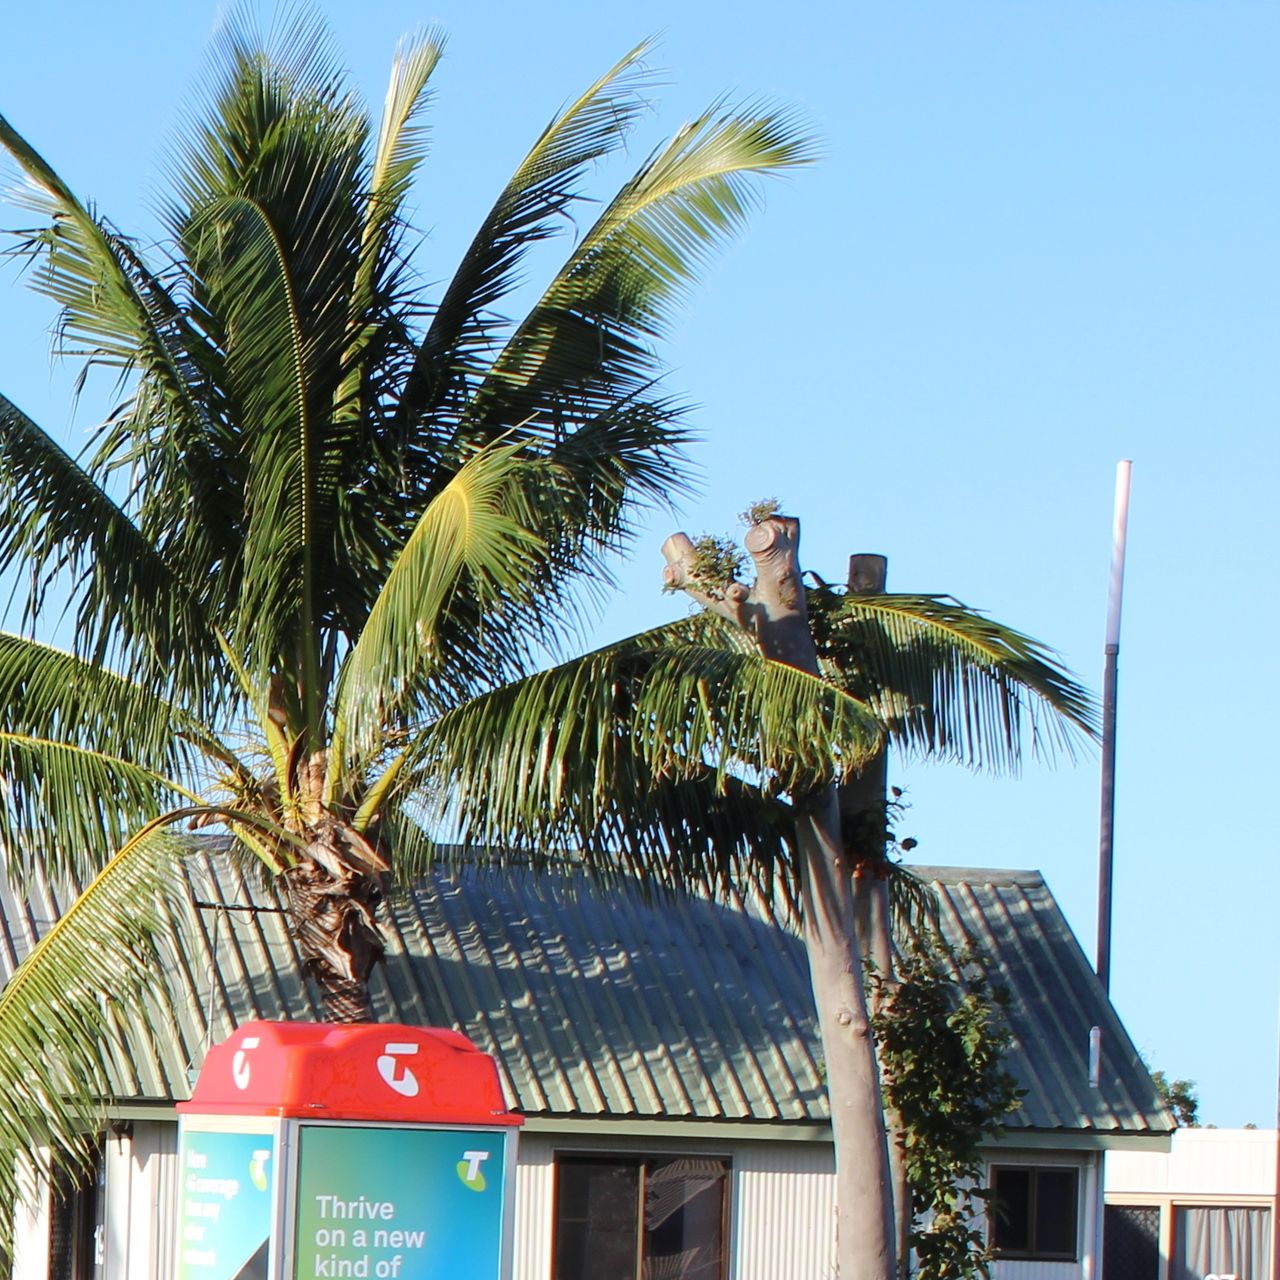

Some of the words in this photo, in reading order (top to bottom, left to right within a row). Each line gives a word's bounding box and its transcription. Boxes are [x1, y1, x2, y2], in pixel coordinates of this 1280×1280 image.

[315, 1195, 395, 1220] Thrive
[315, 1229, 346, 1247] on
[351, 1229, 367, 1247] a
[373, 1230, 425, 1249] new
[314, 1253, 369, 1278] kind
[375, 1254, 403, 1279] of
